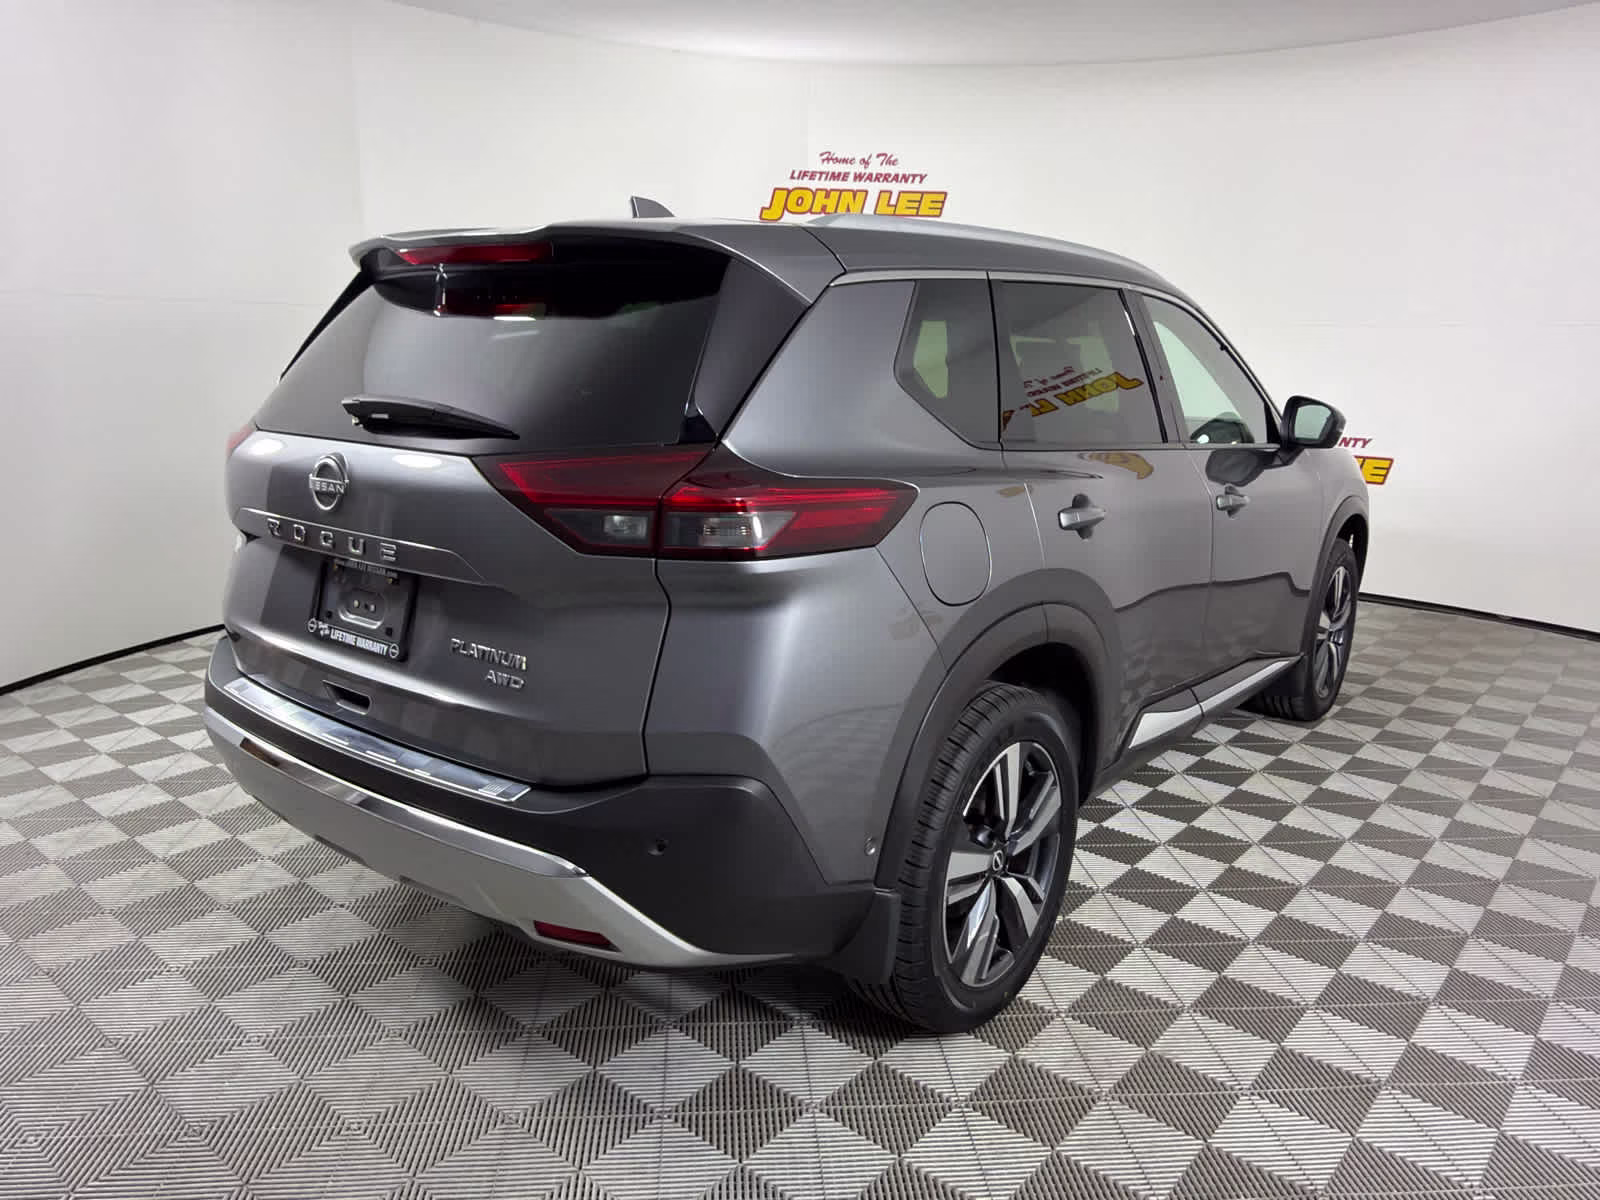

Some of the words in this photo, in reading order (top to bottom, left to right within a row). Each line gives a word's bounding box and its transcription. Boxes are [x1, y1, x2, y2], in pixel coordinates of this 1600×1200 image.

[819, 151, 855, 166] Home
[859, 154, 873, 168] of
[875, 153, 898, 166] The
[789, 170, 850, 183] LIFETIME
[853, 172, 927, 184] WARRANTY
[759, 187, 868, 222] JOHN
[874, 190, 947, 218] LEE
[267, 518, 397, 562] ROGUE
[450, 638, 526, 670] PLATINUM
[485, 669, 524, 689] AWD
